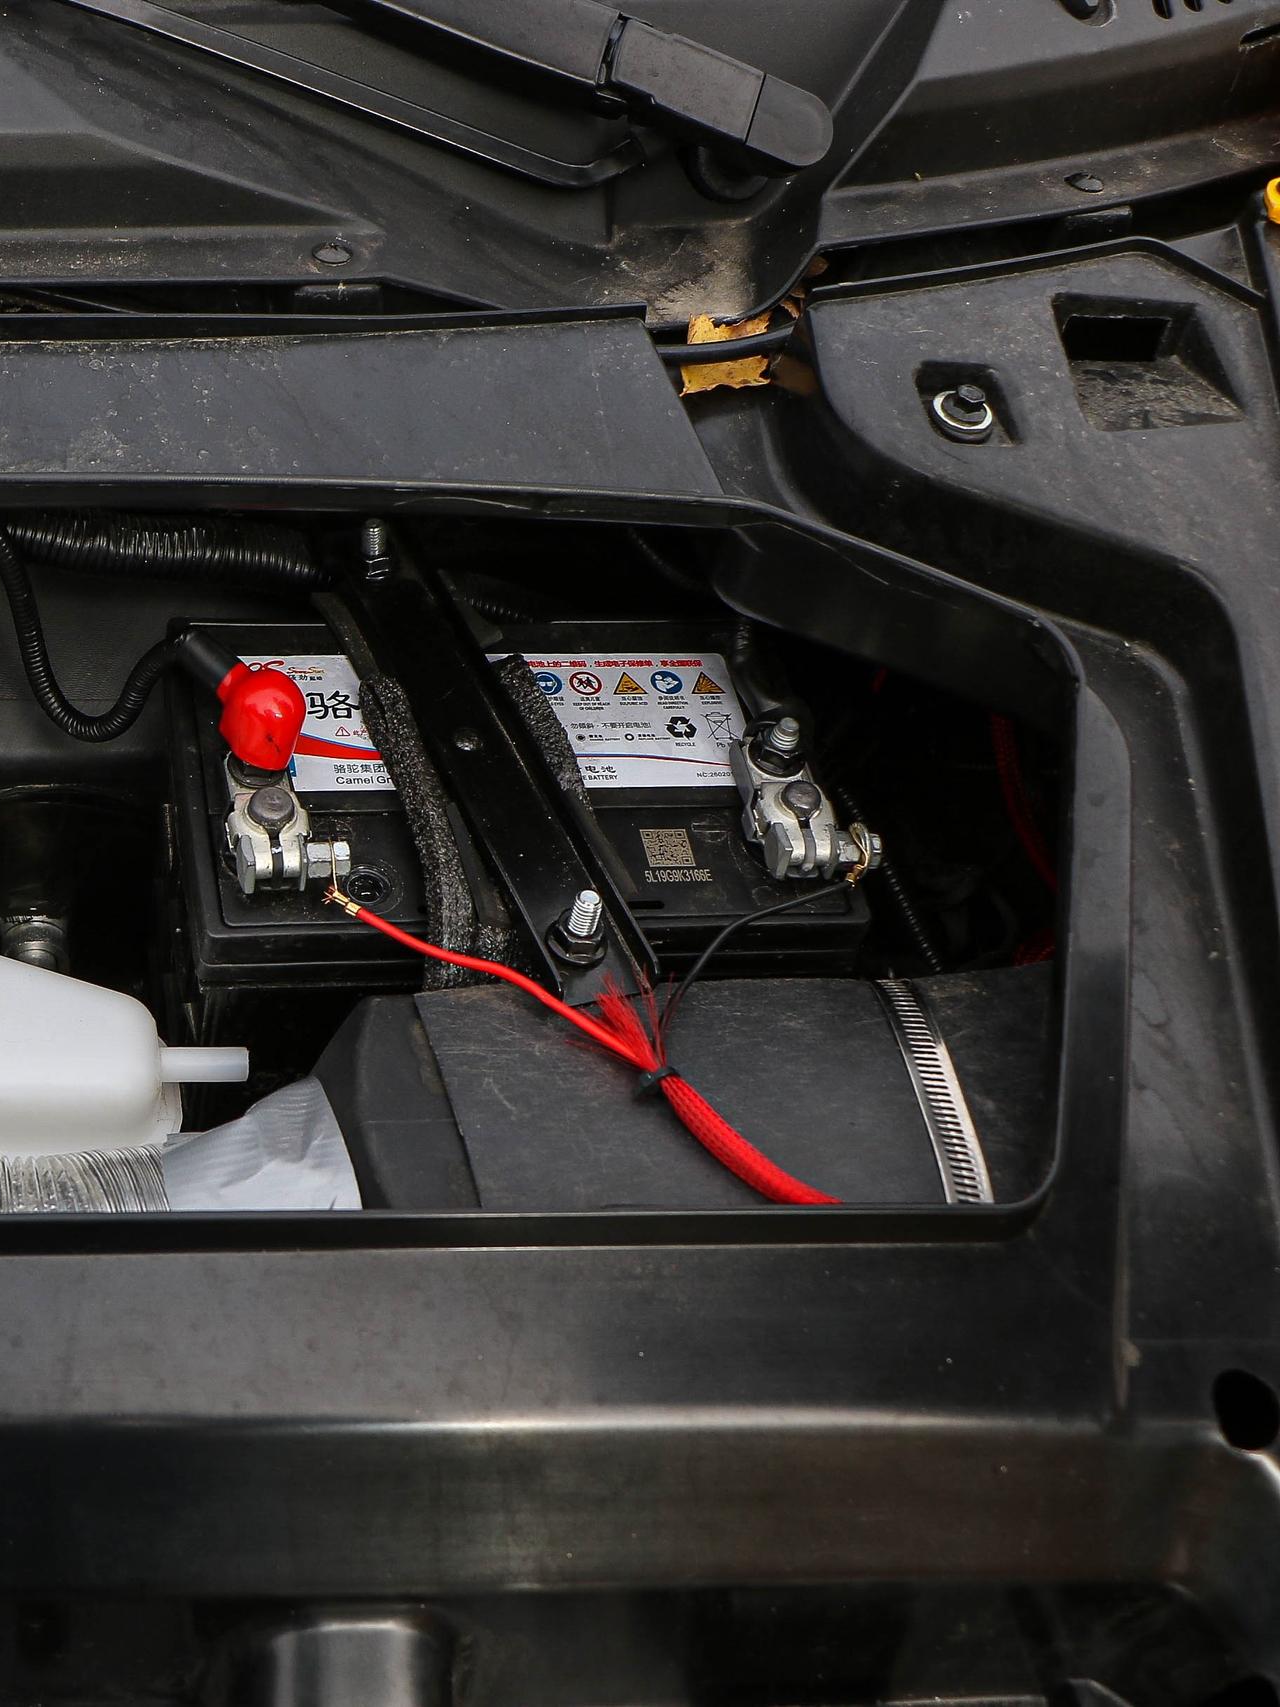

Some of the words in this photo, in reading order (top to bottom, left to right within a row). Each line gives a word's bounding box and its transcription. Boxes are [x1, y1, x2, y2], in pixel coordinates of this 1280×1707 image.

[305, 691, 360, 719] 骆
[333, 764, 386, 774] 骆驼集团
[580, 765, 617, 774] 电池
[335, 776, 374, 785] Camel
